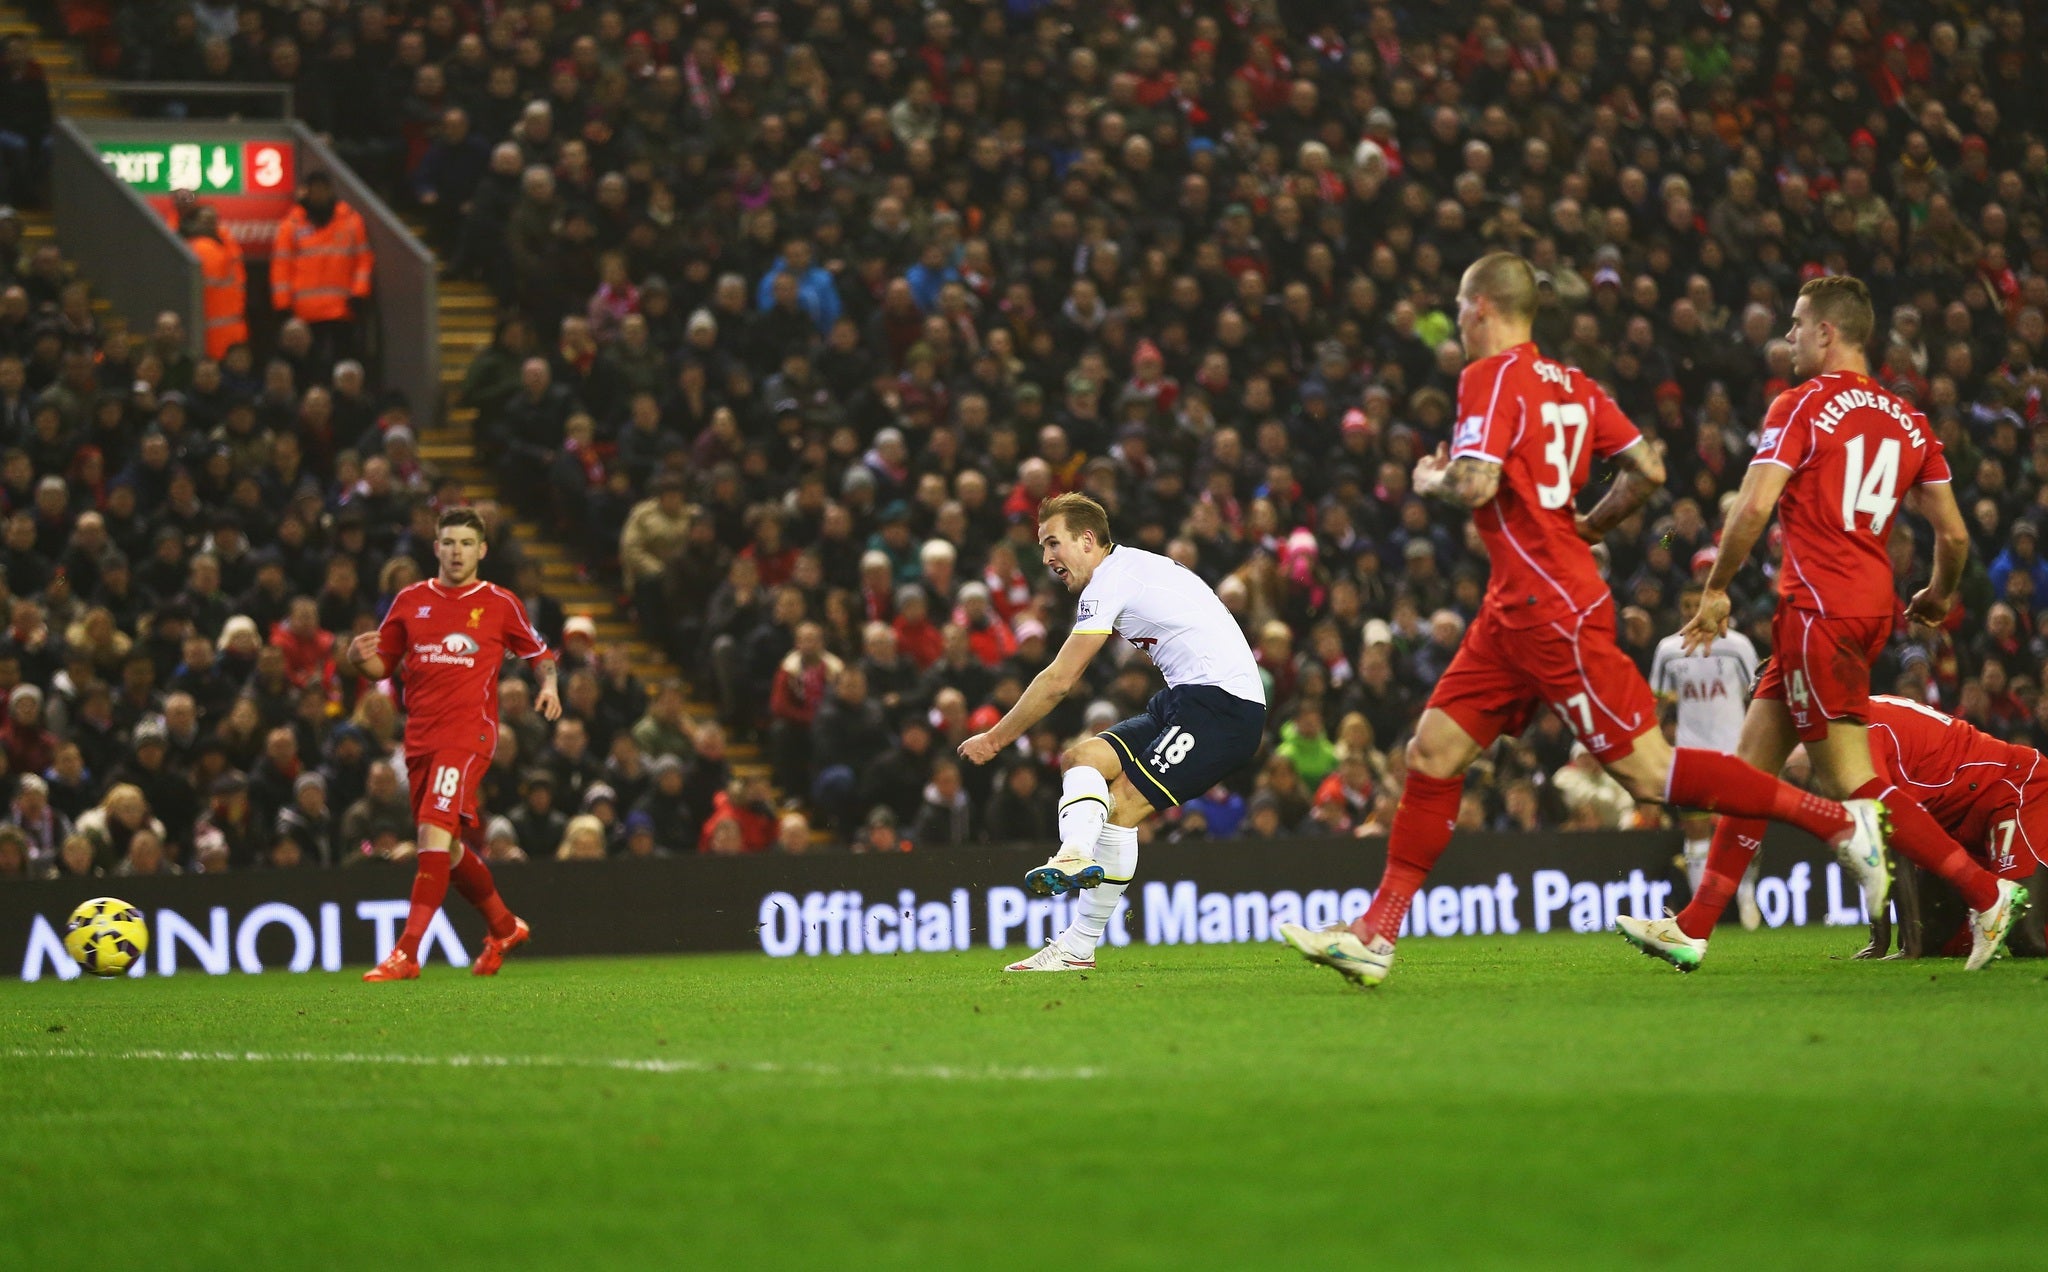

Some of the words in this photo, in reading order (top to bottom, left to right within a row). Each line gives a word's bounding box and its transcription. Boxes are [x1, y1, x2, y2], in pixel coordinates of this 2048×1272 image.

[254, 147, 284, 188] 3
[1814, 388, 1927, 449] HENDERSON
[1536, 401, 1589, 510] 37
[1841, 433, 1902, 536] 14
[1682, 678, 1728, 700] AIA
[1154, 725, 1196, 765] 18
[433, 765, 460, 798] 18
[759, 887, 971, 957] Official
[1756, 861, 1812, 929] of
